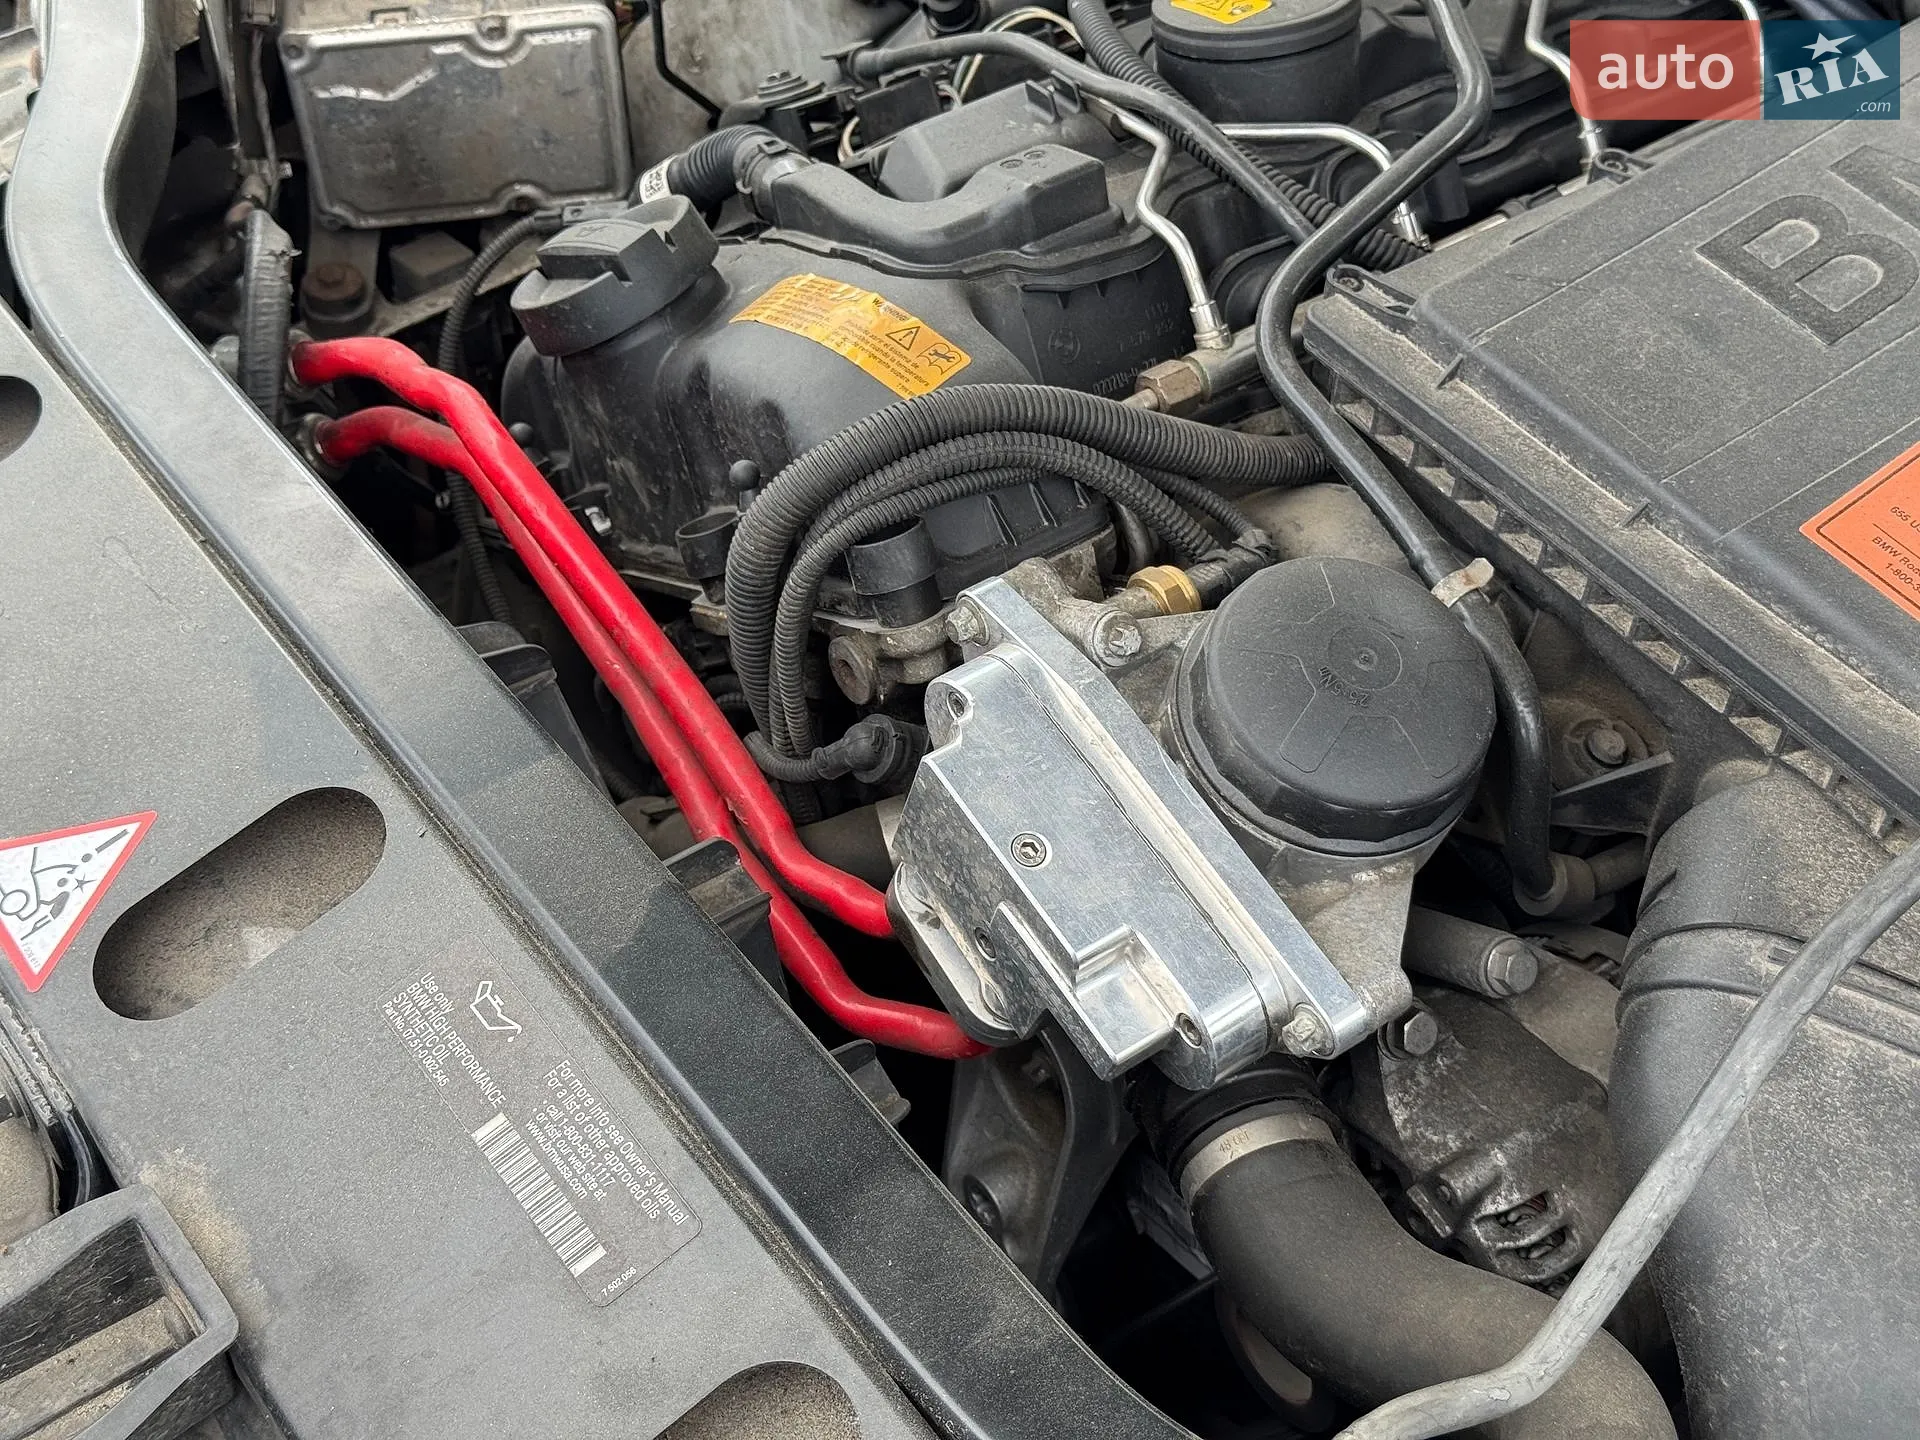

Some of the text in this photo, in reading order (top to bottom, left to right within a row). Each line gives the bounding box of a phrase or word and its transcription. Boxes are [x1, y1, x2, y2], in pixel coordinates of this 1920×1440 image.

[882, 341, 891, 349] el
[888, 346, 912, 363] sistema
[910, 361, 920, 369] de
[1872, 536, 1902, 557] BMW
[1890, 506, 1911, 521] 655
[393, 992, 450, 1064] SYNTHETIC OIL
[421, 972, 454, 1014] Use only
[382, 1001, 398, 1019] Part
[393, 1015, 408, 1032] No.
[423, 1056, 439, 1073] 002
[433, 1070, 449, 1086] 545
[407, 982, 506, 1108] BMW HIGH PERFORMANCE
[527, 1119, 592, 1199] www.bmwusa.com
[536, 1113, 607, 1201] or visit our web site at
[543, 1069, 660, 1218] For a list of other approved oils
[544, 1105, 615, 1186] call 1-800-831-1117
[556, 1060, 575, 1082] For
[569, 1079, 594, 1106] more
[605, 1125, 624, 1145] see
[620, 1142, 660, 1186] Owner's
[651, 1182, 689, 1225] Manual
[602, 1288, 607, 1296] 7
[608, 1278, 623, 1292] 502
